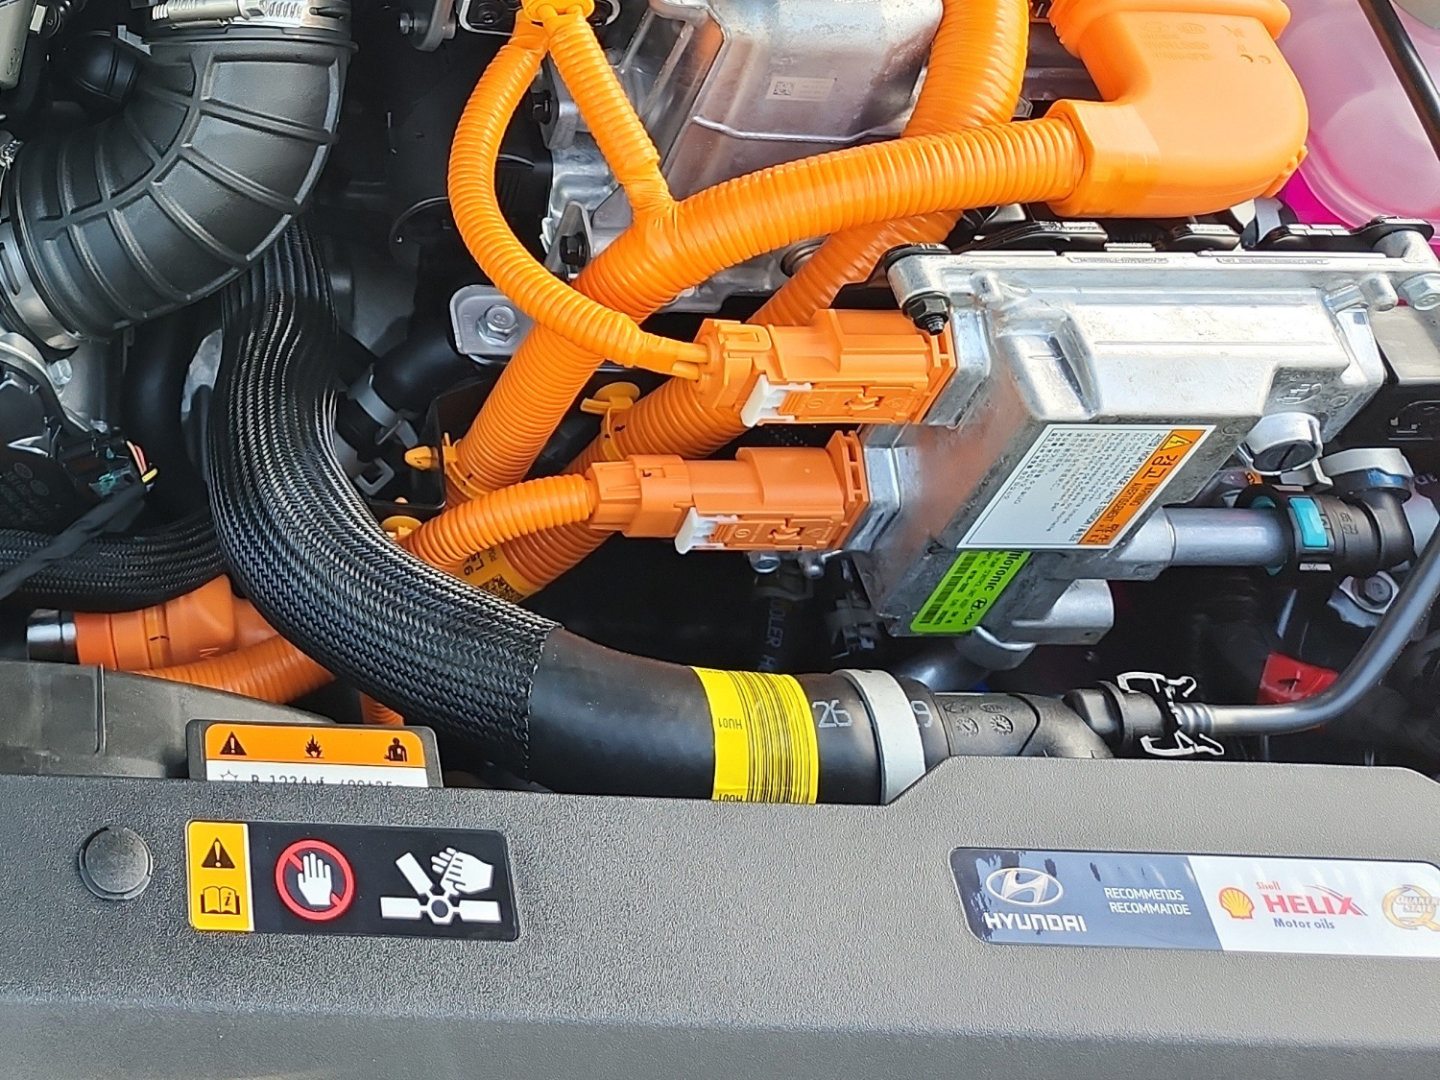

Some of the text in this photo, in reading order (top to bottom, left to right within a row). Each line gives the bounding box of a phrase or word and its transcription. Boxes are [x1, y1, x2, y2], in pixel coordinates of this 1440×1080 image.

[1137, 454, 1180, 479] 경고
[718, 716, 743, 730] HU01
[811, 699, 852, 729] 26
[1104, 887, 1185, 901] RECOMMENDS
[1109, 901, 1192, 916] RECOMMANDE
[1262, 894, 1363, 916] HELIX
[983, 911, 1088, 933] HYUNDAI
[1273, 917, 1336, 930] Motor oils
